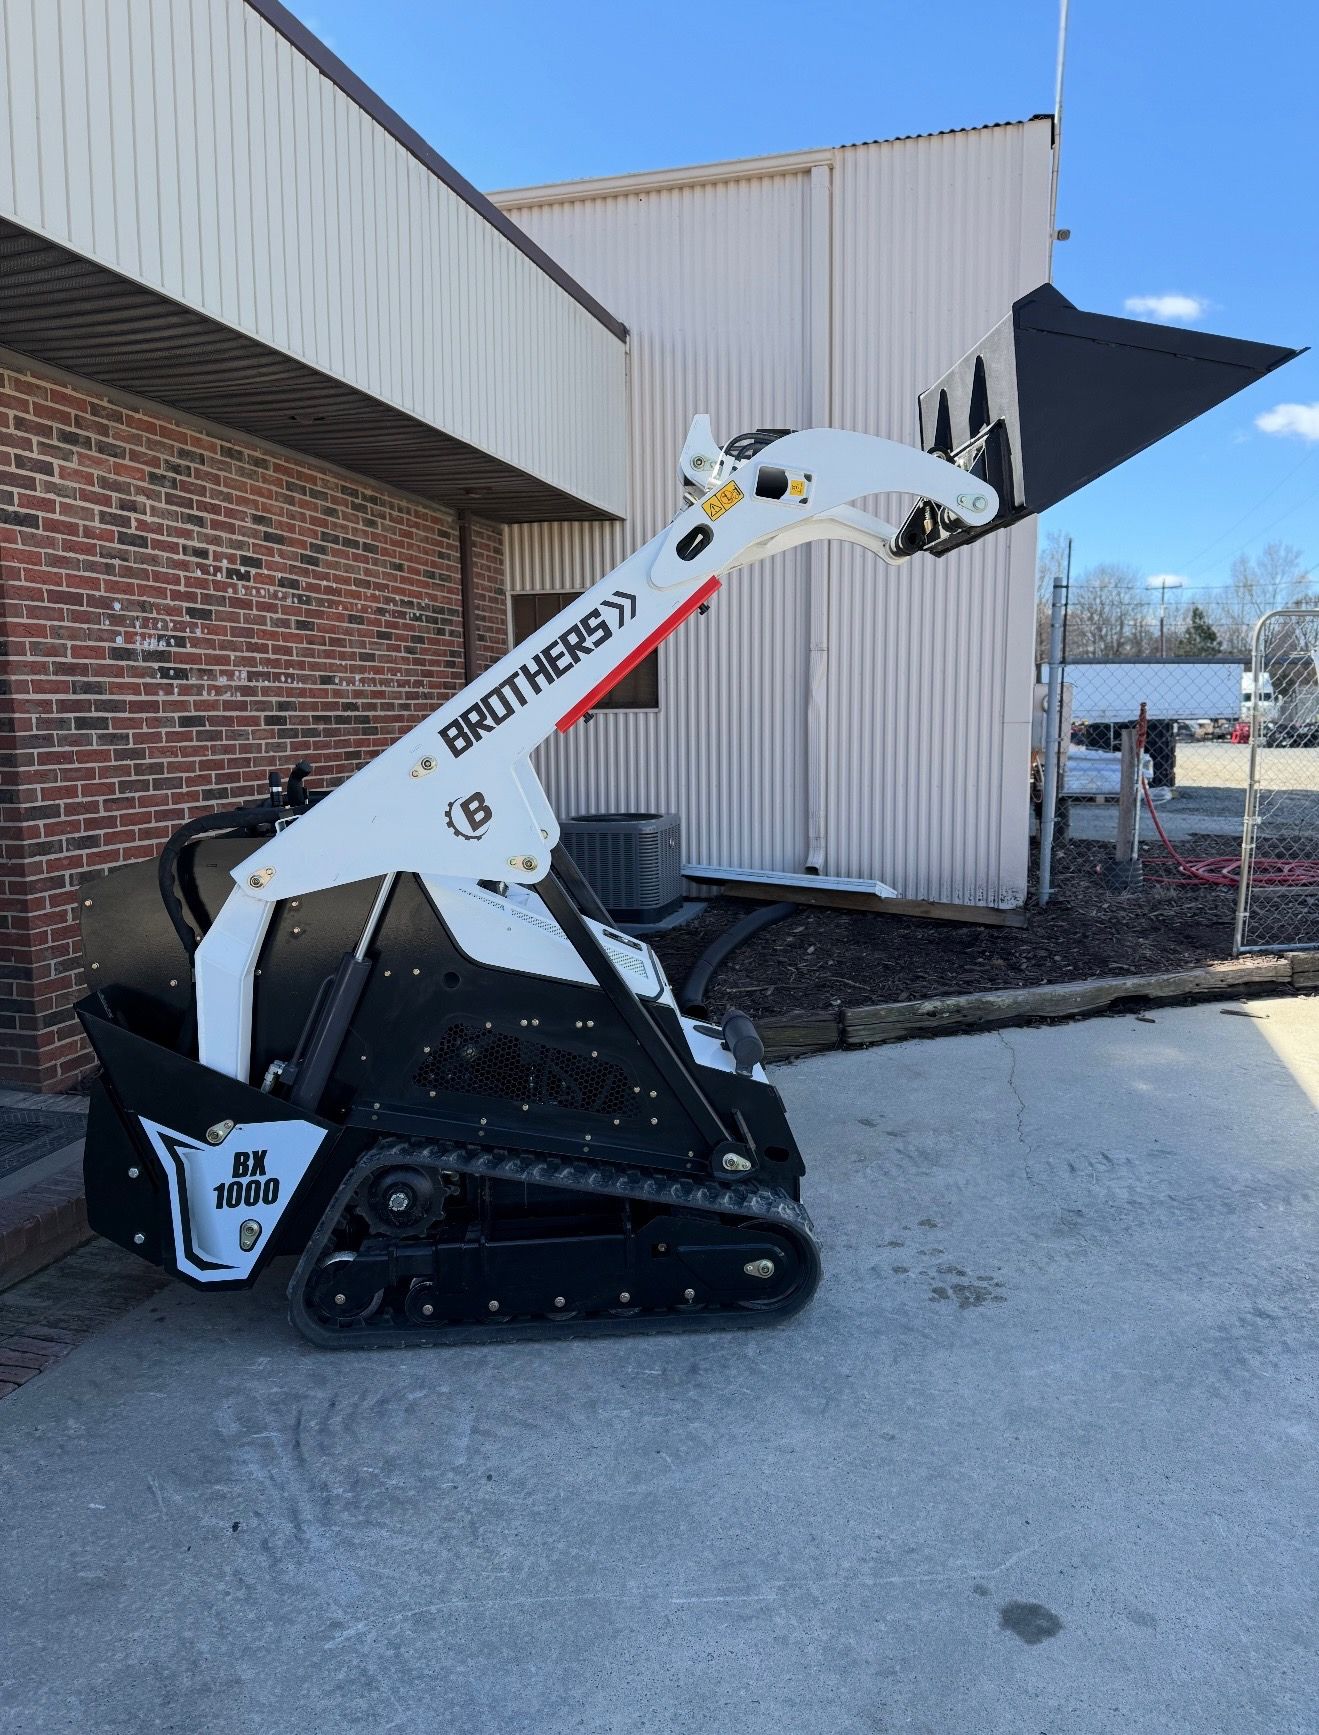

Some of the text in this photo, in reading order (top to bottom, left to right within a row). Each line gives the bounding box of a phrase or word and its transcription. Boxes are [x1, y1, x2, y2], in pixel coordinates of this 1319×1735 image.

[438, 608, 613, 759] BROTHERS
[460, 791, 493, 833] B
[231, 1149, 268, 1178] BX
[213, 1177, 280, 1209] 1000
